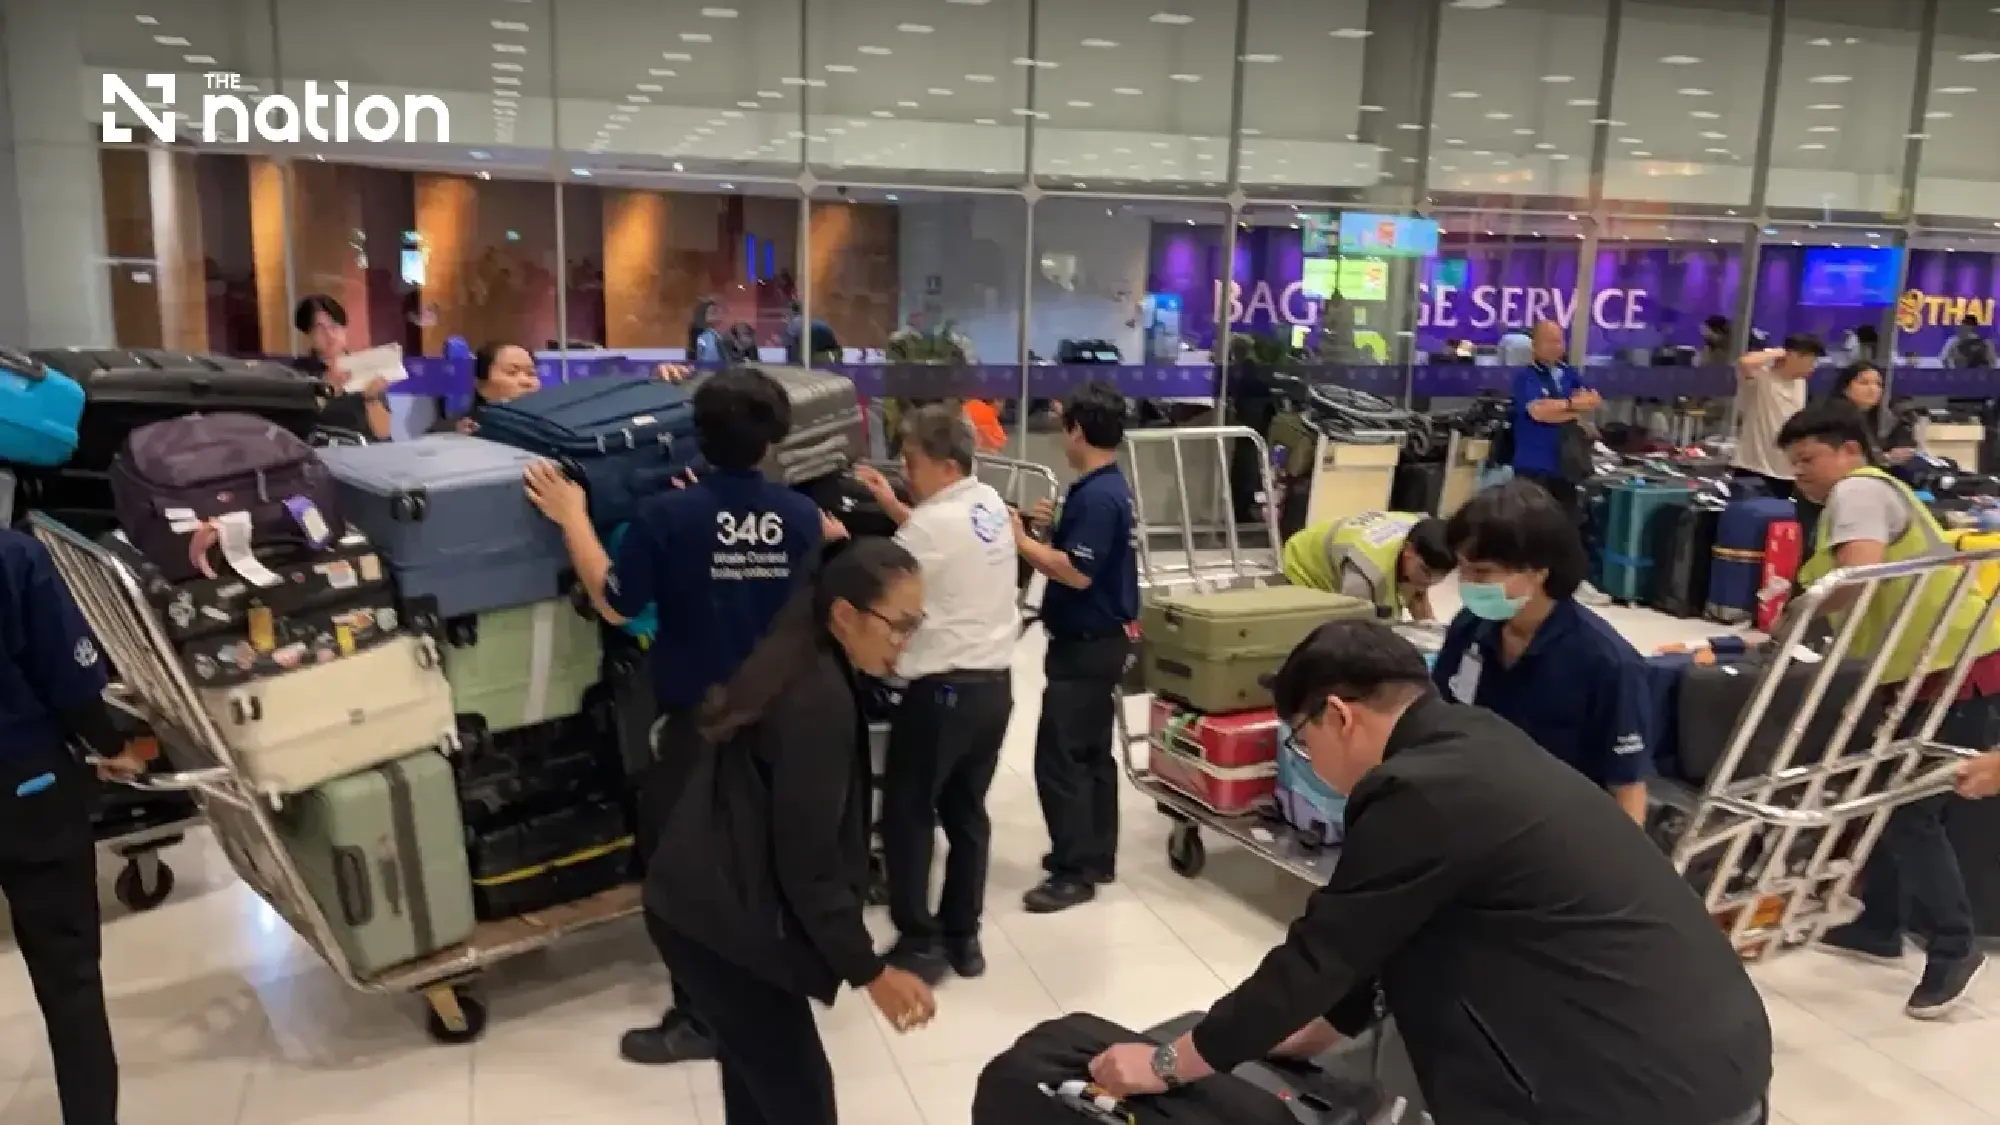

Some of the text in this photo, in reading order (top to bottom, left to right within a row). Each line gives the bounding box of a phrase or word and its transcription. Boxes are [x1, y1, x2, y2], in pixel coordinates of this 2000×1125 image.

[1470, 285, 1648, 330] SERVCE
[1924, 296, 1996, 327] THAI
[716, 511, 784, 546] 346
